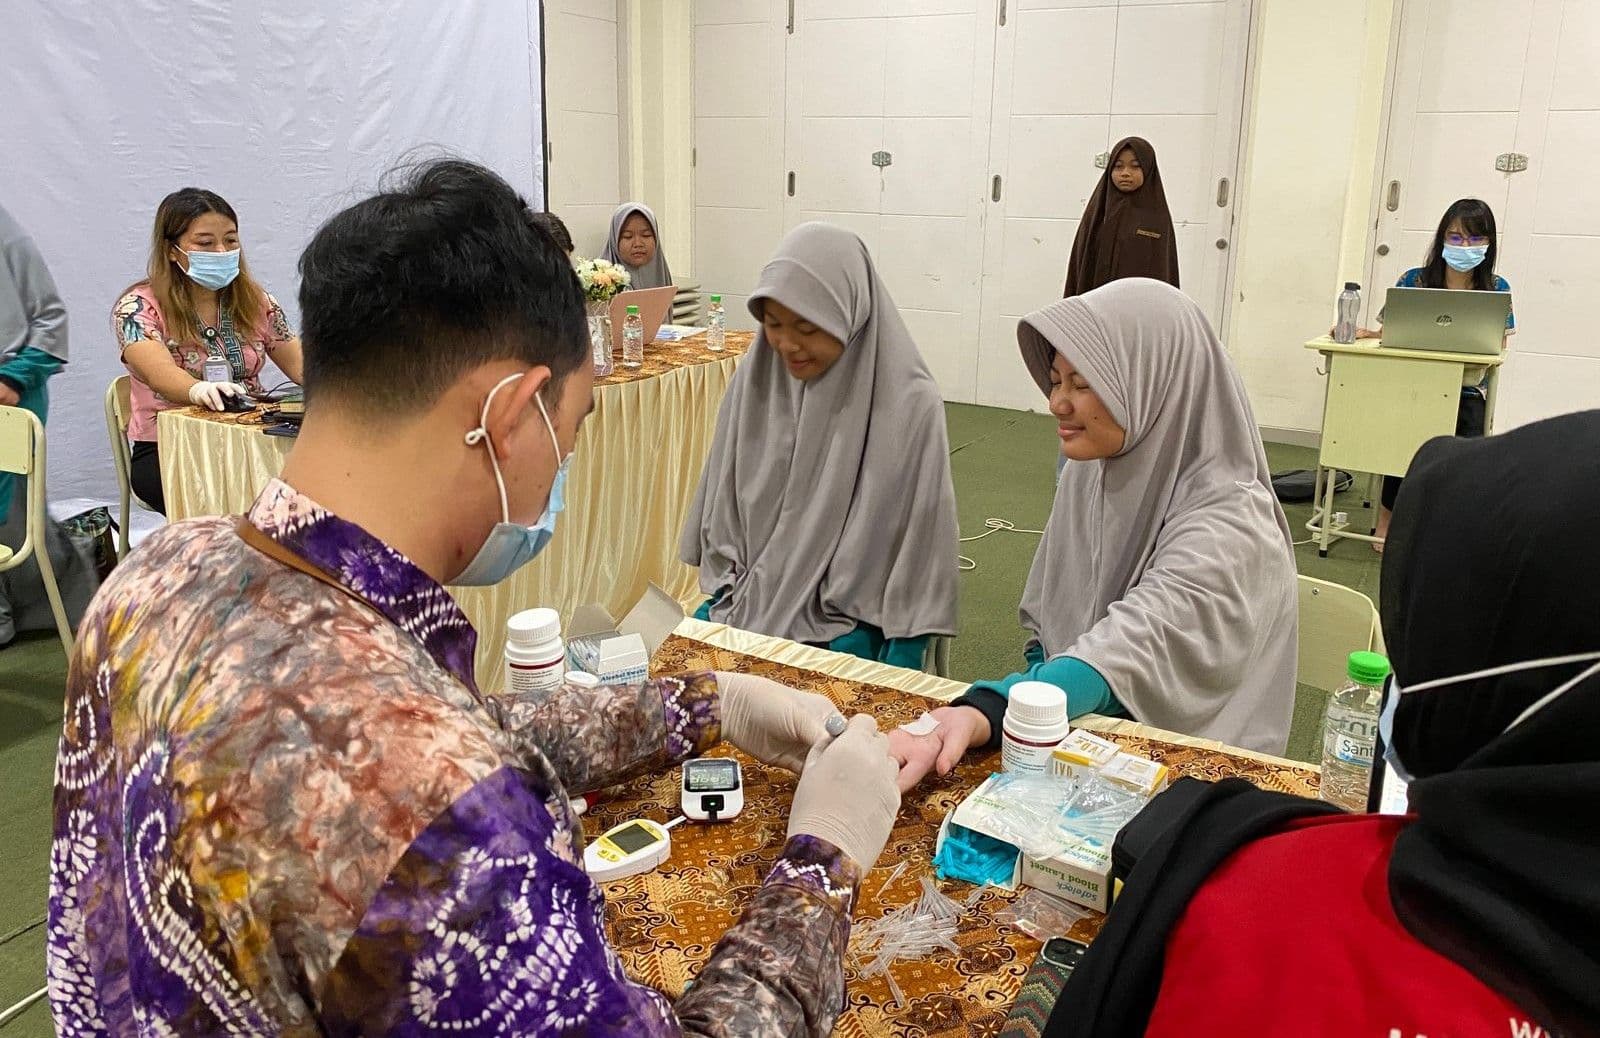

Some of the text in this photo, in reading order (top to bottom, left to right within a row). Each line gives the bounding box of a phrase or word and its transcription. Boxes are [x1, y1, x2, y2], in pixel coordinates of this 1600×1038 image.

[600, 671, 625, 682] Alcohol
[1029, 860, 1100, 892] Blood Lancet
